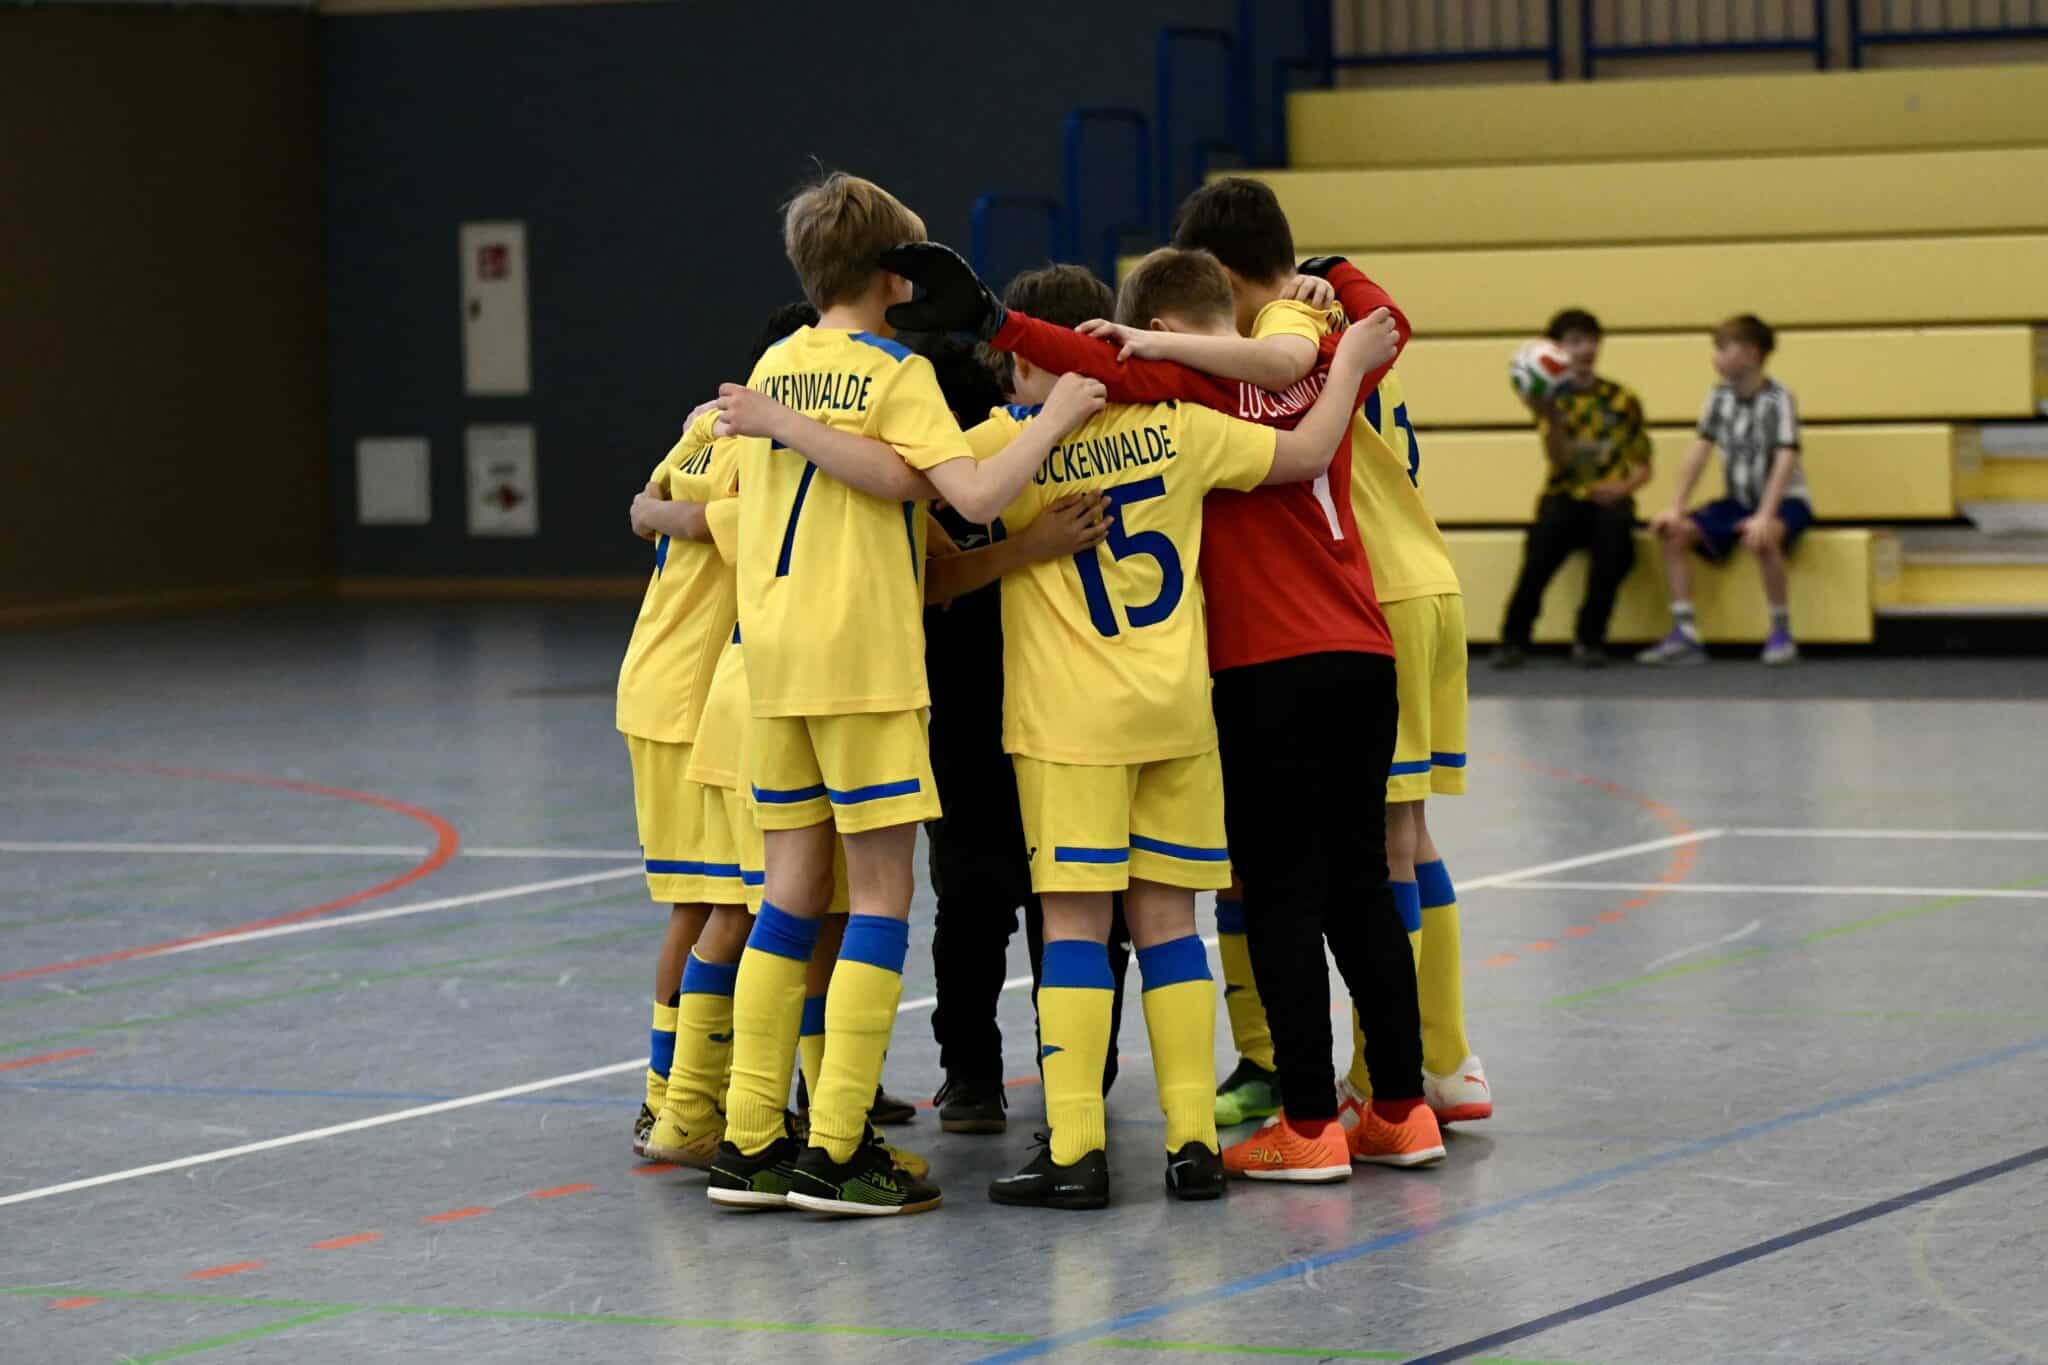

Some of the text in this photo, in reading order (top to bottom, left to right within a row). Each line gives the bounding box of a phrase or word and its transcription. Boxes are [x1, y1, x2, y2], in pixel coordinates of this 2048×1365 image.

[1033, 425, 1176, 486] UCKENWALDE
[1073, 475, 1184, 637] 15
[1248, 1148, 1283, 1163] FILA
[871, 1172, 897, 1191] FILA
